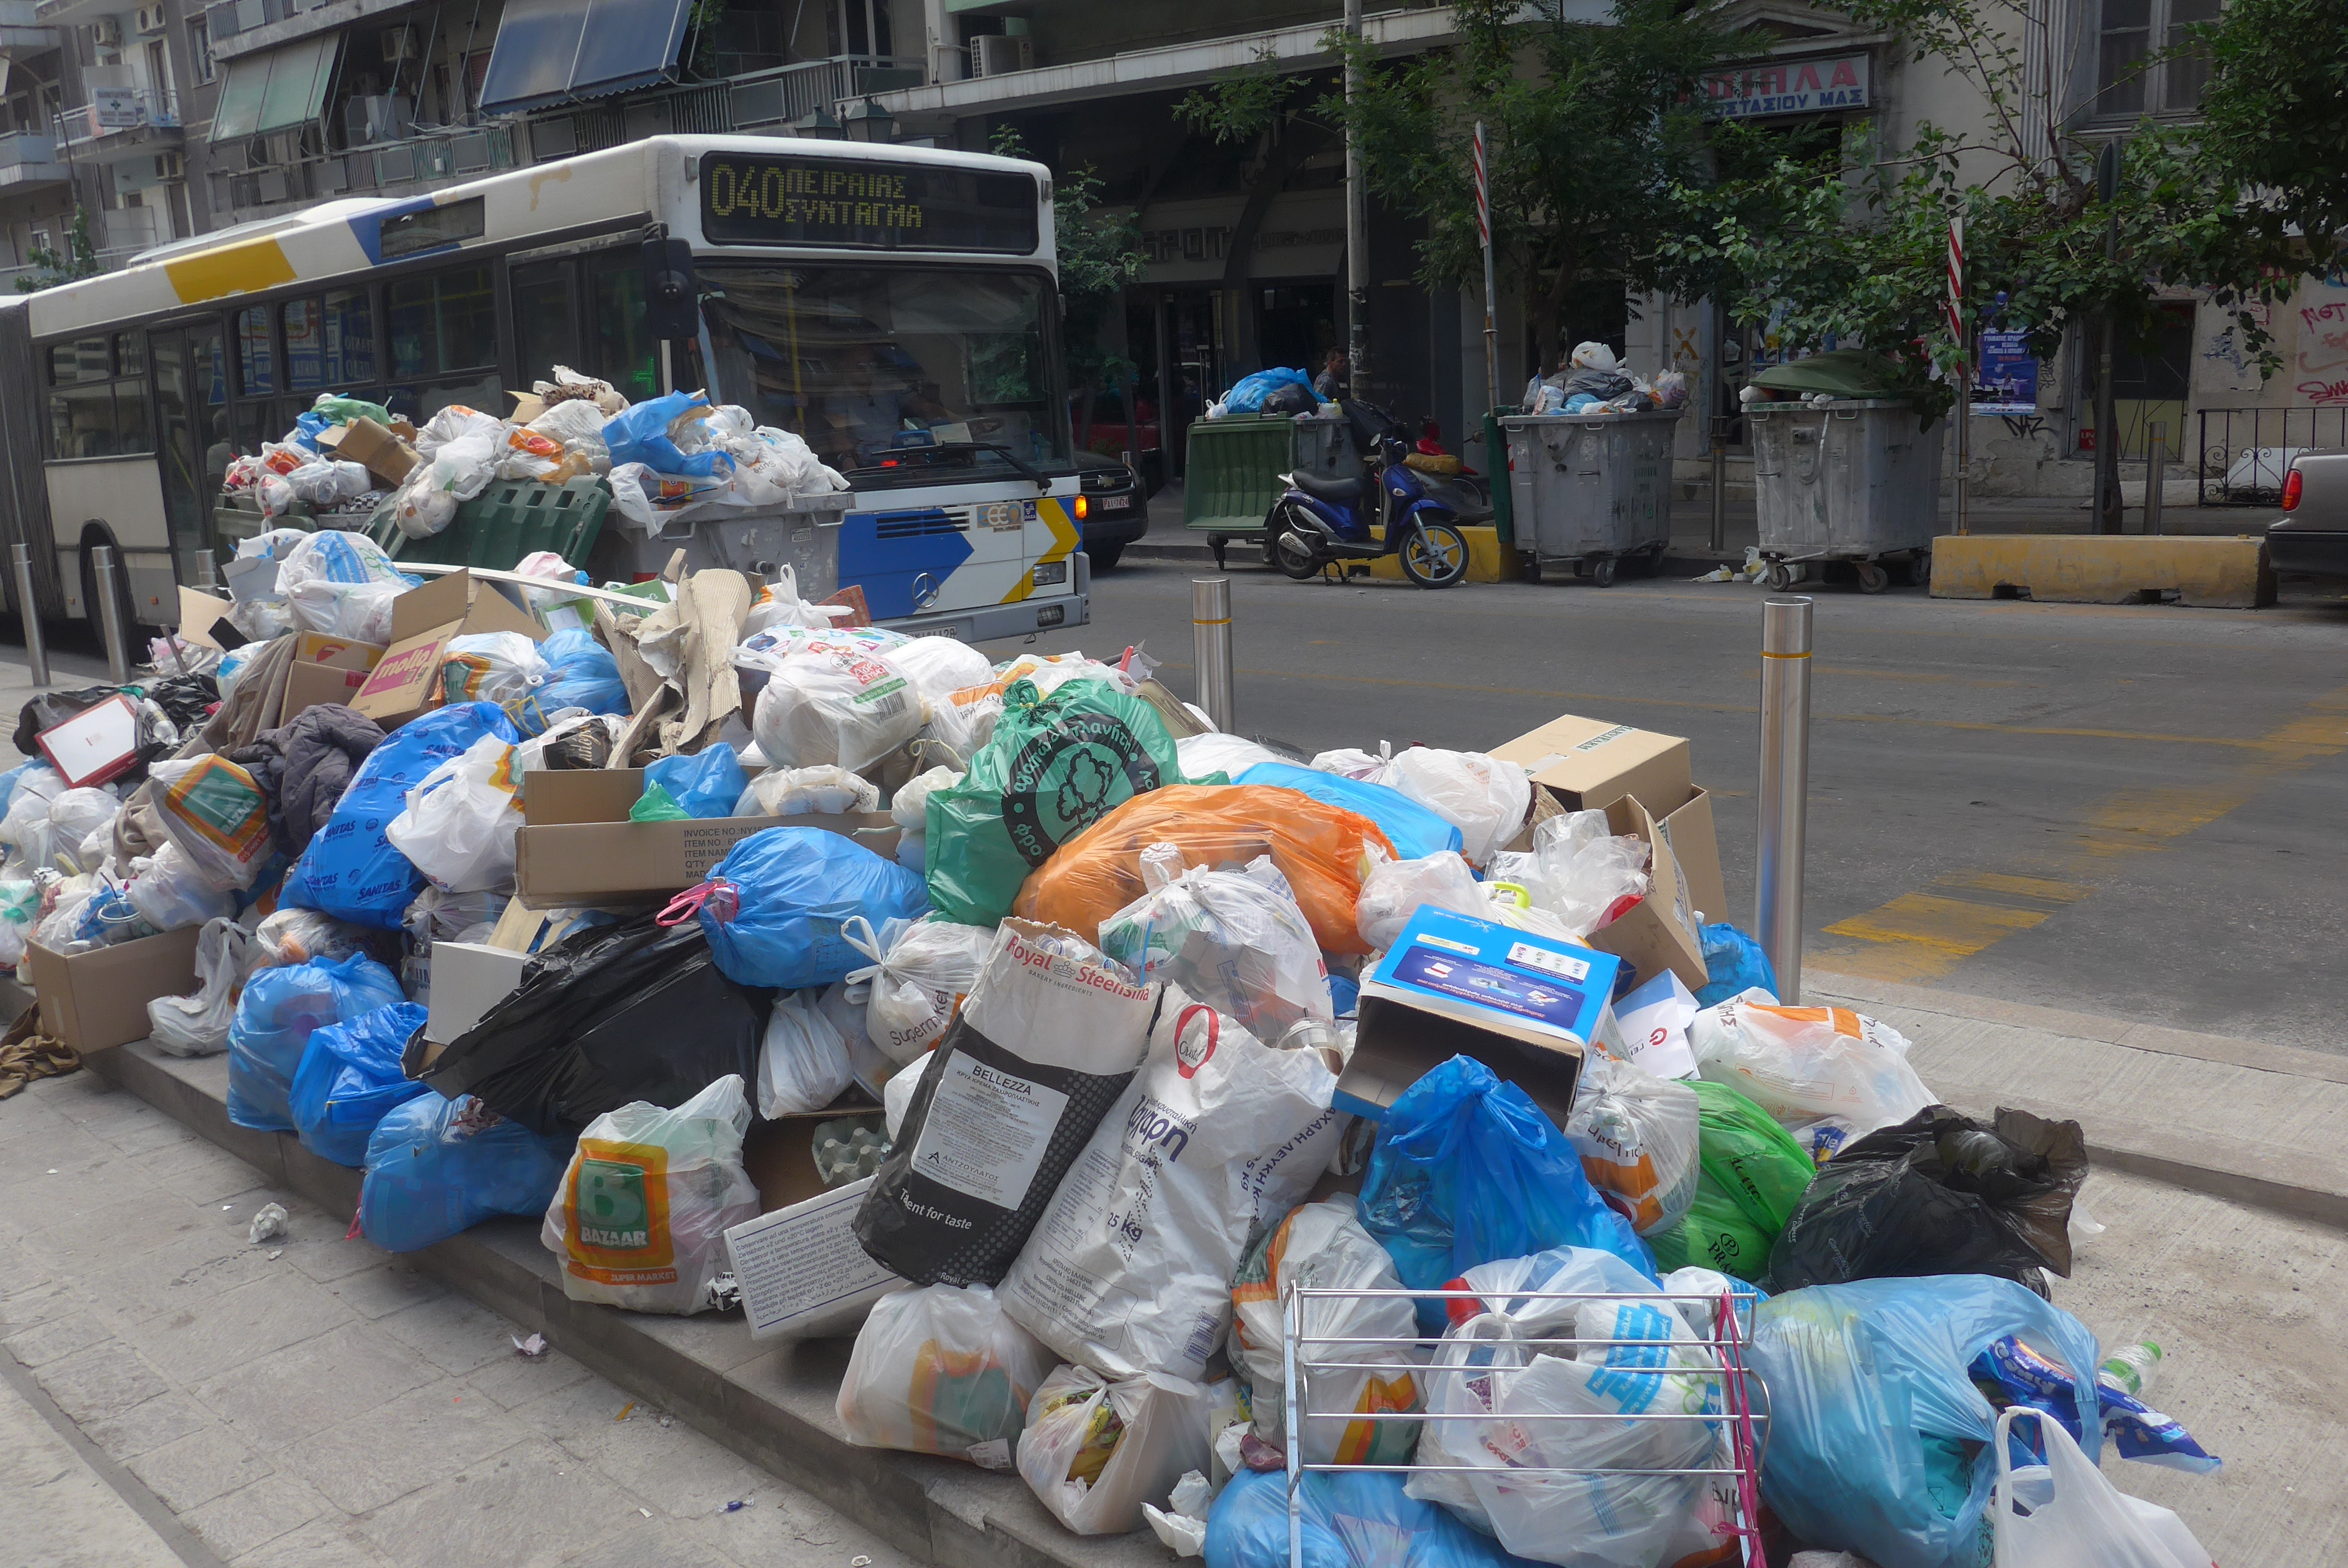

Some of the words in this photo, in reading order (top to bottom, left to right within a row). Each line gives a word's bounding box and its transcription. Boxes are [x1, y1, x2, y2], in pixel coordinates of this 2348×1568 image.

[1820, 89, 1863, 107] ΜΑΣ
[712, 164, 785, 218] 040
[786, 168, 906, 199] ΠΕΙΡΑΙΑΣ
[786, 199, 923, 228] ΣΥΝΤΑΓΜΑ
[375, 649, 431, 681] molto
[1050, 726, 1069, 743] ον
[325, 820, 356, 838] ANITAS
[684, 828, 720, 838] INVOICE
[684, 840, 707, 849] ITEM
[684, 850, 707, 858] ITEM
[686, 871, 709, 879] MAD
[357, 880, 402, 901] SANITAS
[1006, 935, 1054, 971] Royal
[1028, 969, 1052, 984] BAKERY
[1054, 980, 1094, 997] INGREDIENTS
[972, 1065, 1031, 1096] BELLEZZA
[1294, 1106, 1337, 1144] ΑΧΑΡΗ
[943, 1154, 1000, 1182] ΑΝΤΖΟΥΛΑΤΟΣ
[926, 1206, 944, 1221] for
[945, 1214, 973, 1230] taste
[581, 1226, 648, 1248] BAZAAR
[611, 1270, 635, 1282] SUPER
[636, 1270, 676, 1282] MARKET
[940, 1272, 960, 1285] Royal
